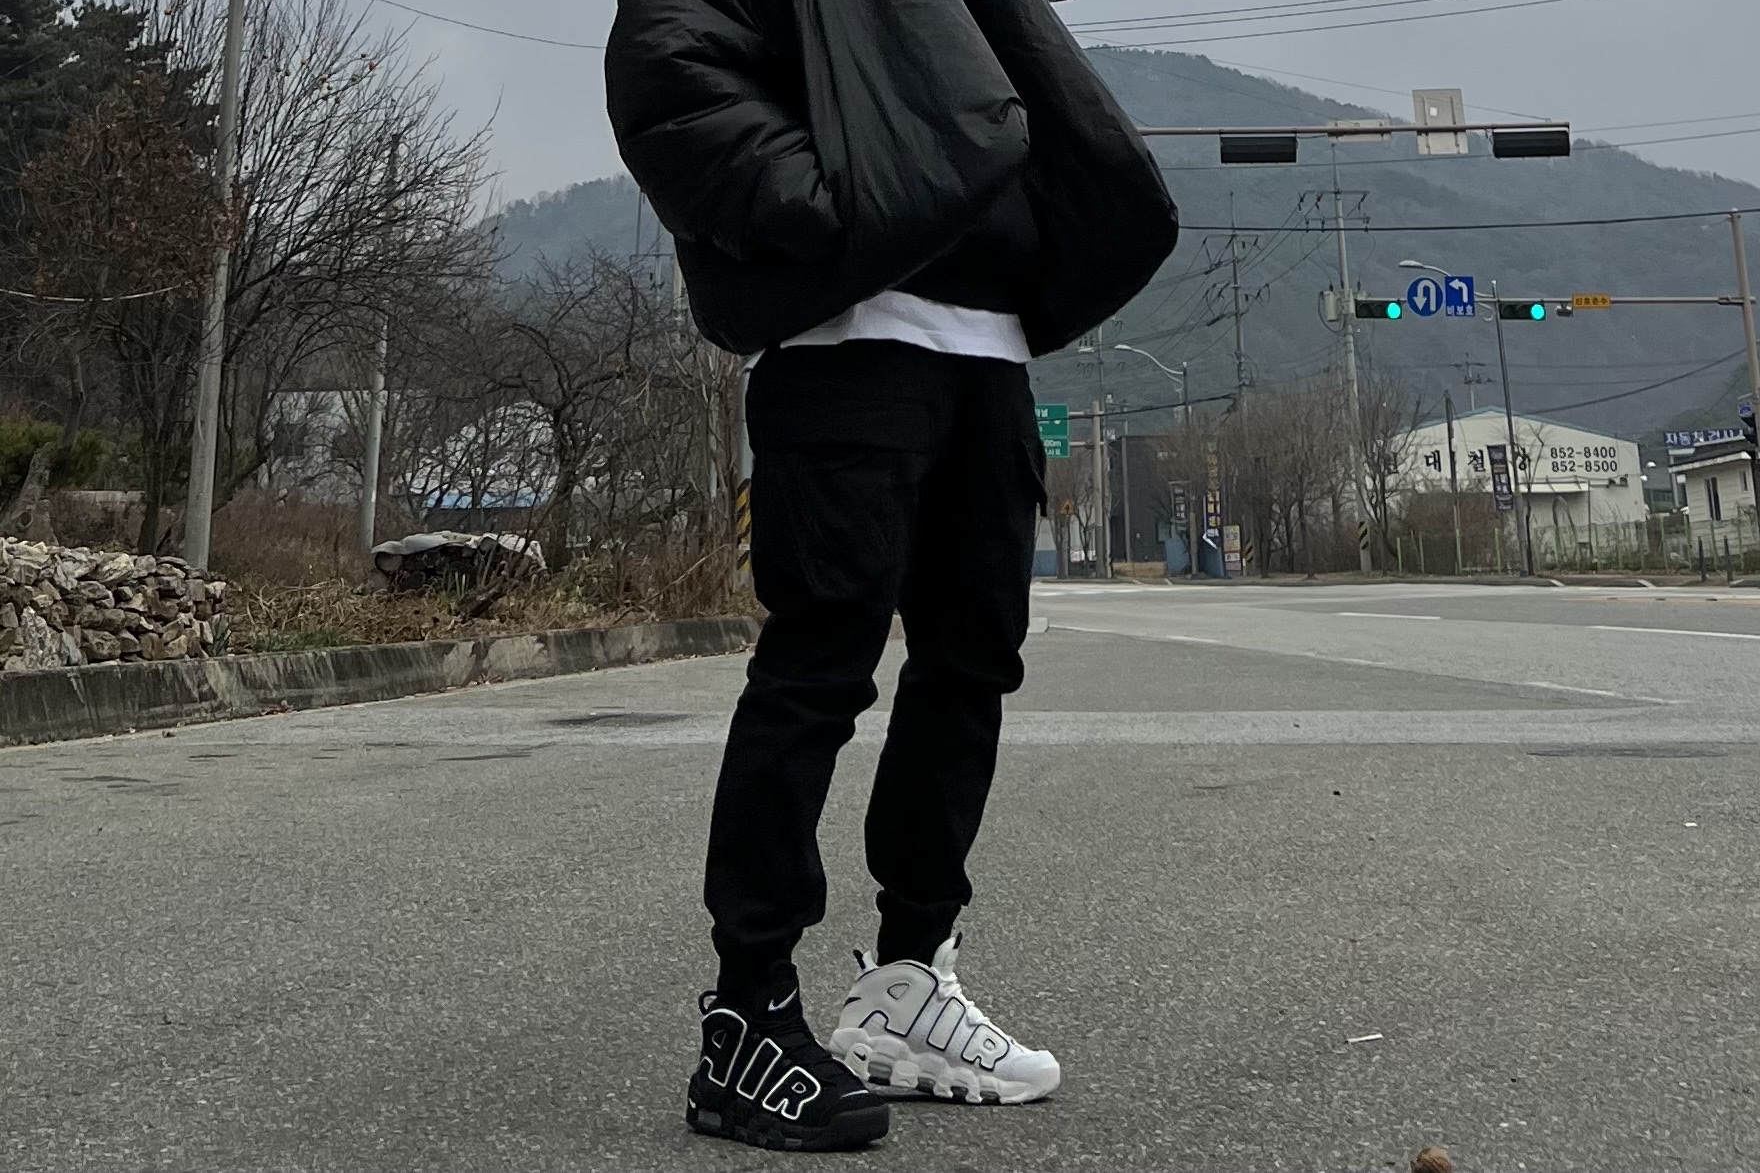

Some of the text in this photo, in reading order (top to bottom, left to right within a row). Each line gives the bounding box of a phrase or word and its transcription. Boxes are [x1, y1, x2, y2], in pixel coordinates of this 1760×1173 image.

[1446, 304, 1474, 317] 비보호
[1550, 446, 1616, 459] 852-8400
[1551, 460, 1618, 473] 852-8500
[858, 962, 1010, 1071] AIR
[701, 1008, 821, 1120] AIR
